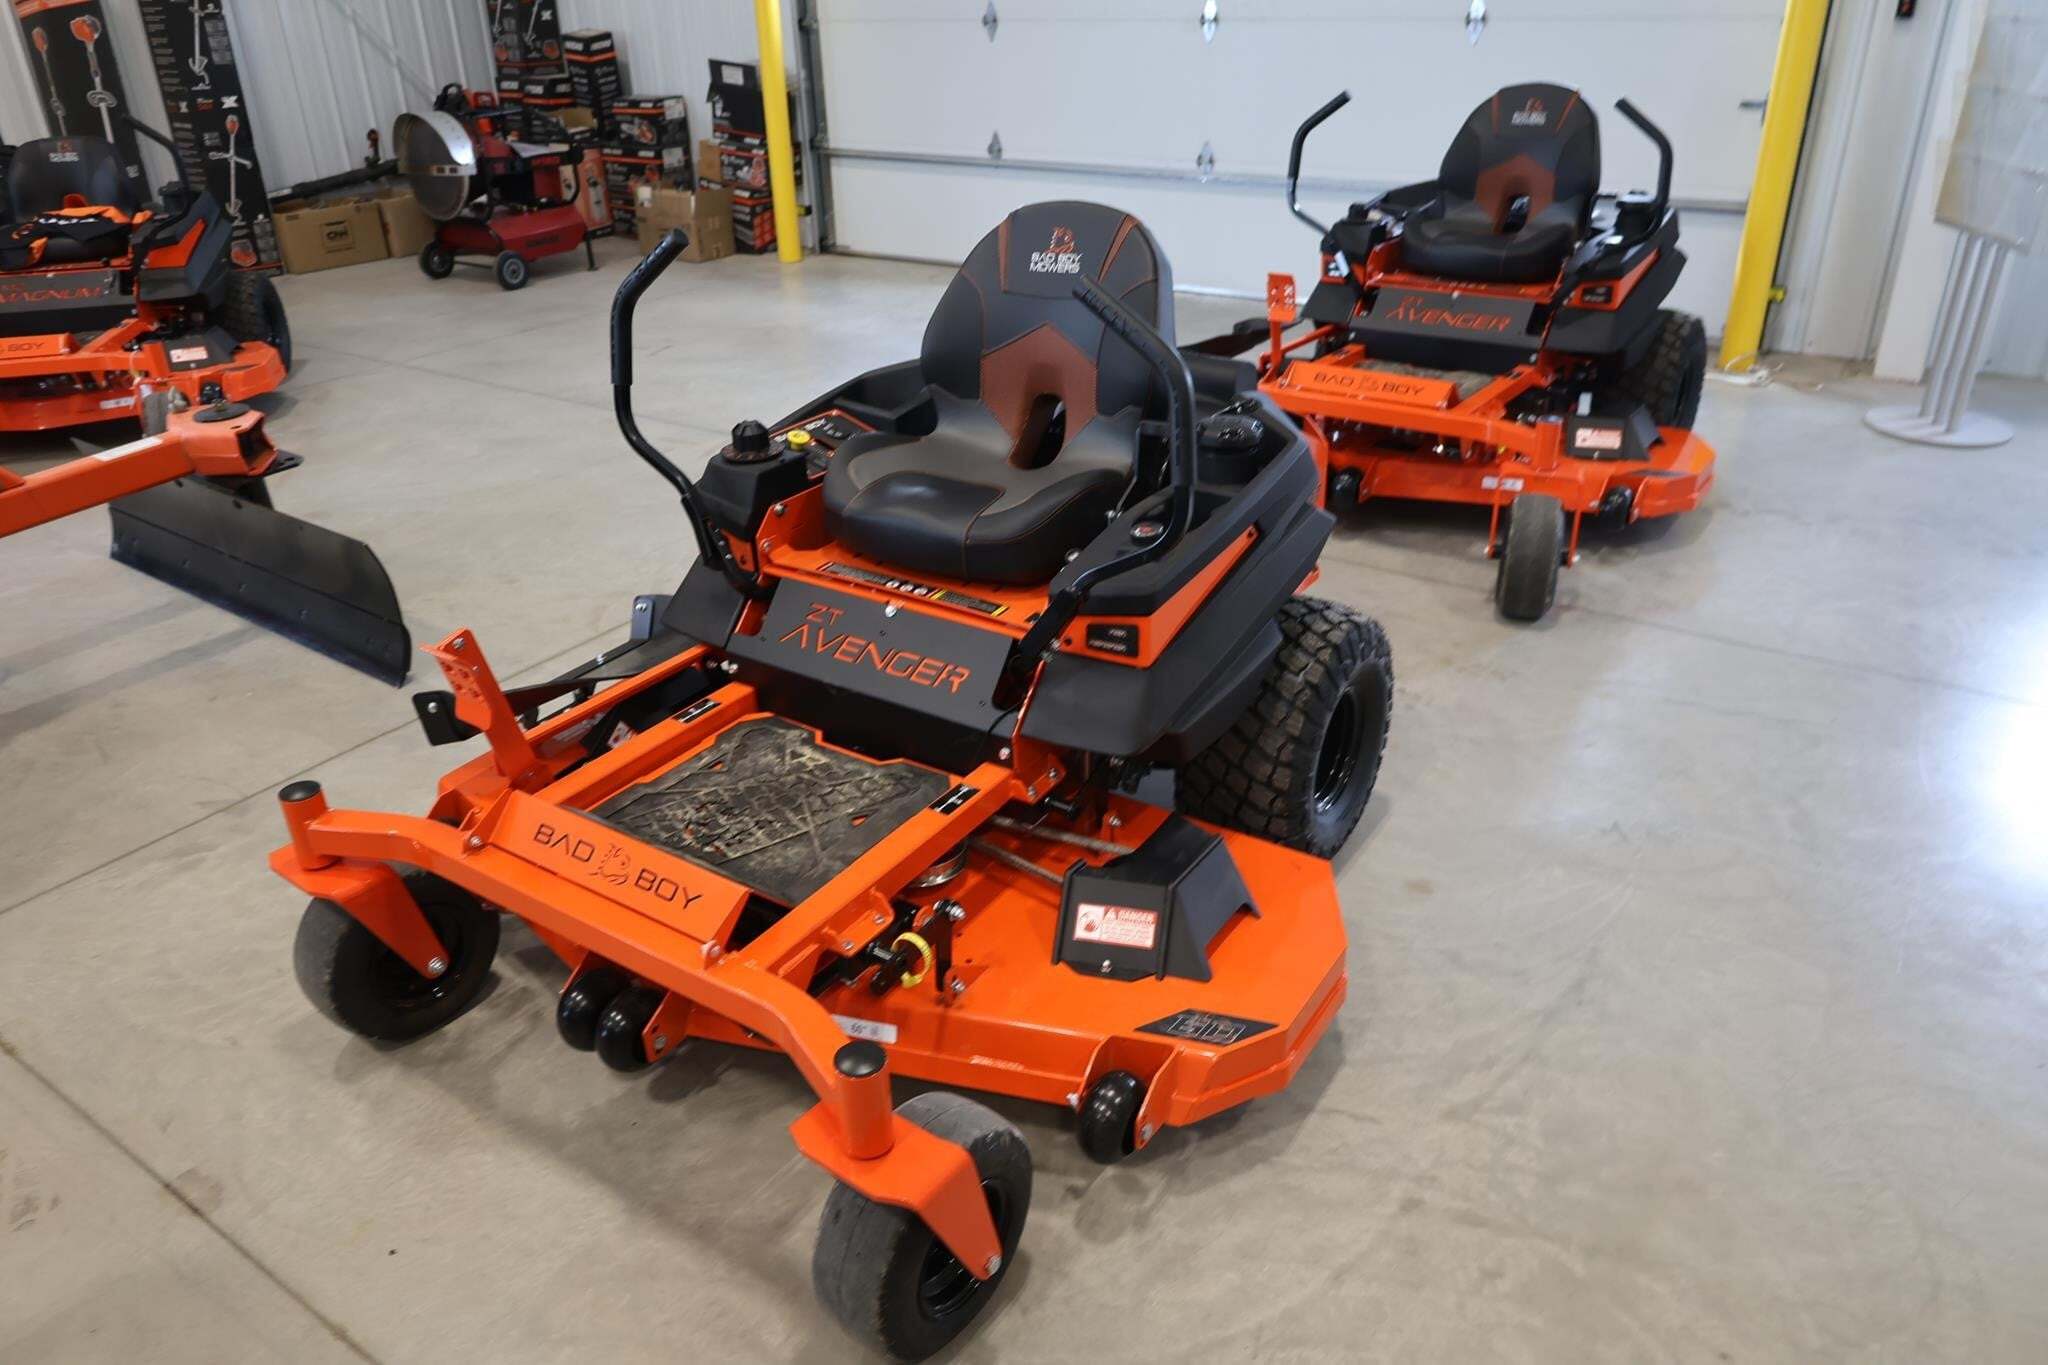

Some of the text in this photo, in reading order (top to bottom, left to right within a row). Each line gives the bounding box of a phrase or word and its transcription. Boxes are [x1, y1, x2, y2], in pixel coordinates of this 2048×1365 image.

[1029, 261, 1081, 273] MOWERS
[1031, 251, 1083, 265] BAD BOY
[1384, 304, 1511, 332] AVENGER
[1313, 371, 1424, 396] BAD BOY
[806, 602, 845, 626] ZT
[778, 623, 971, 694] AVENGER
[534, 823, 702, 910] BAD BOY
